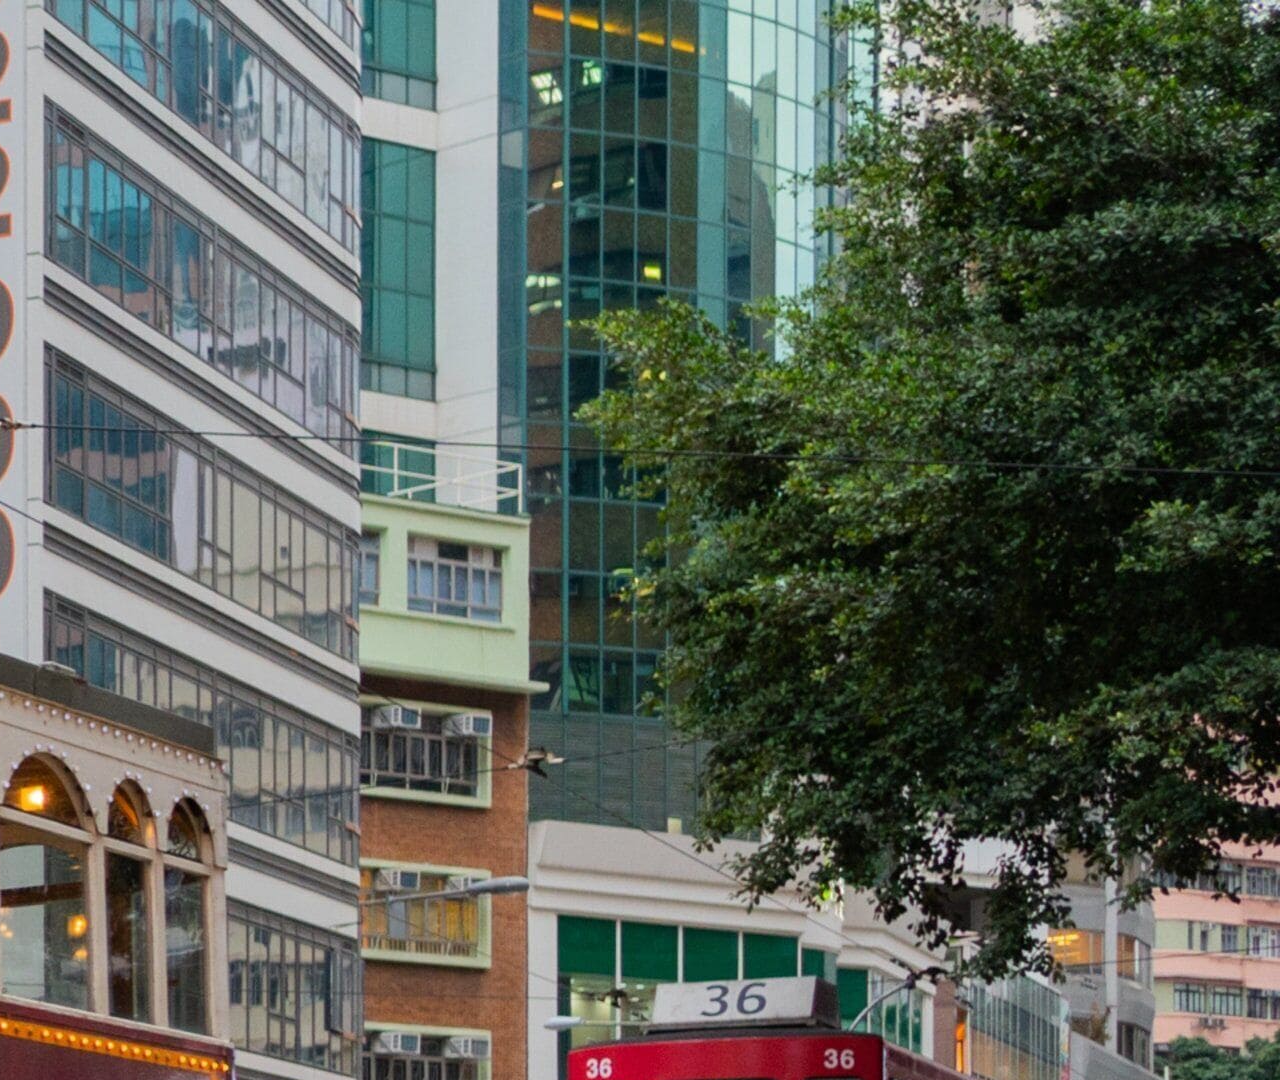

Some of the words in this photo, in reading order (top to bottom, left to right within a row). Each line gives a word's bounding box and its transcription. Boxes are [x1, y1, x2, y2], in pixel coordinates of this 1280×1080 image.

[700, 982, 767, 1017] 36
[585, 1057, 613, 1079] 36
[823, 1048, 856, 1071] 36
